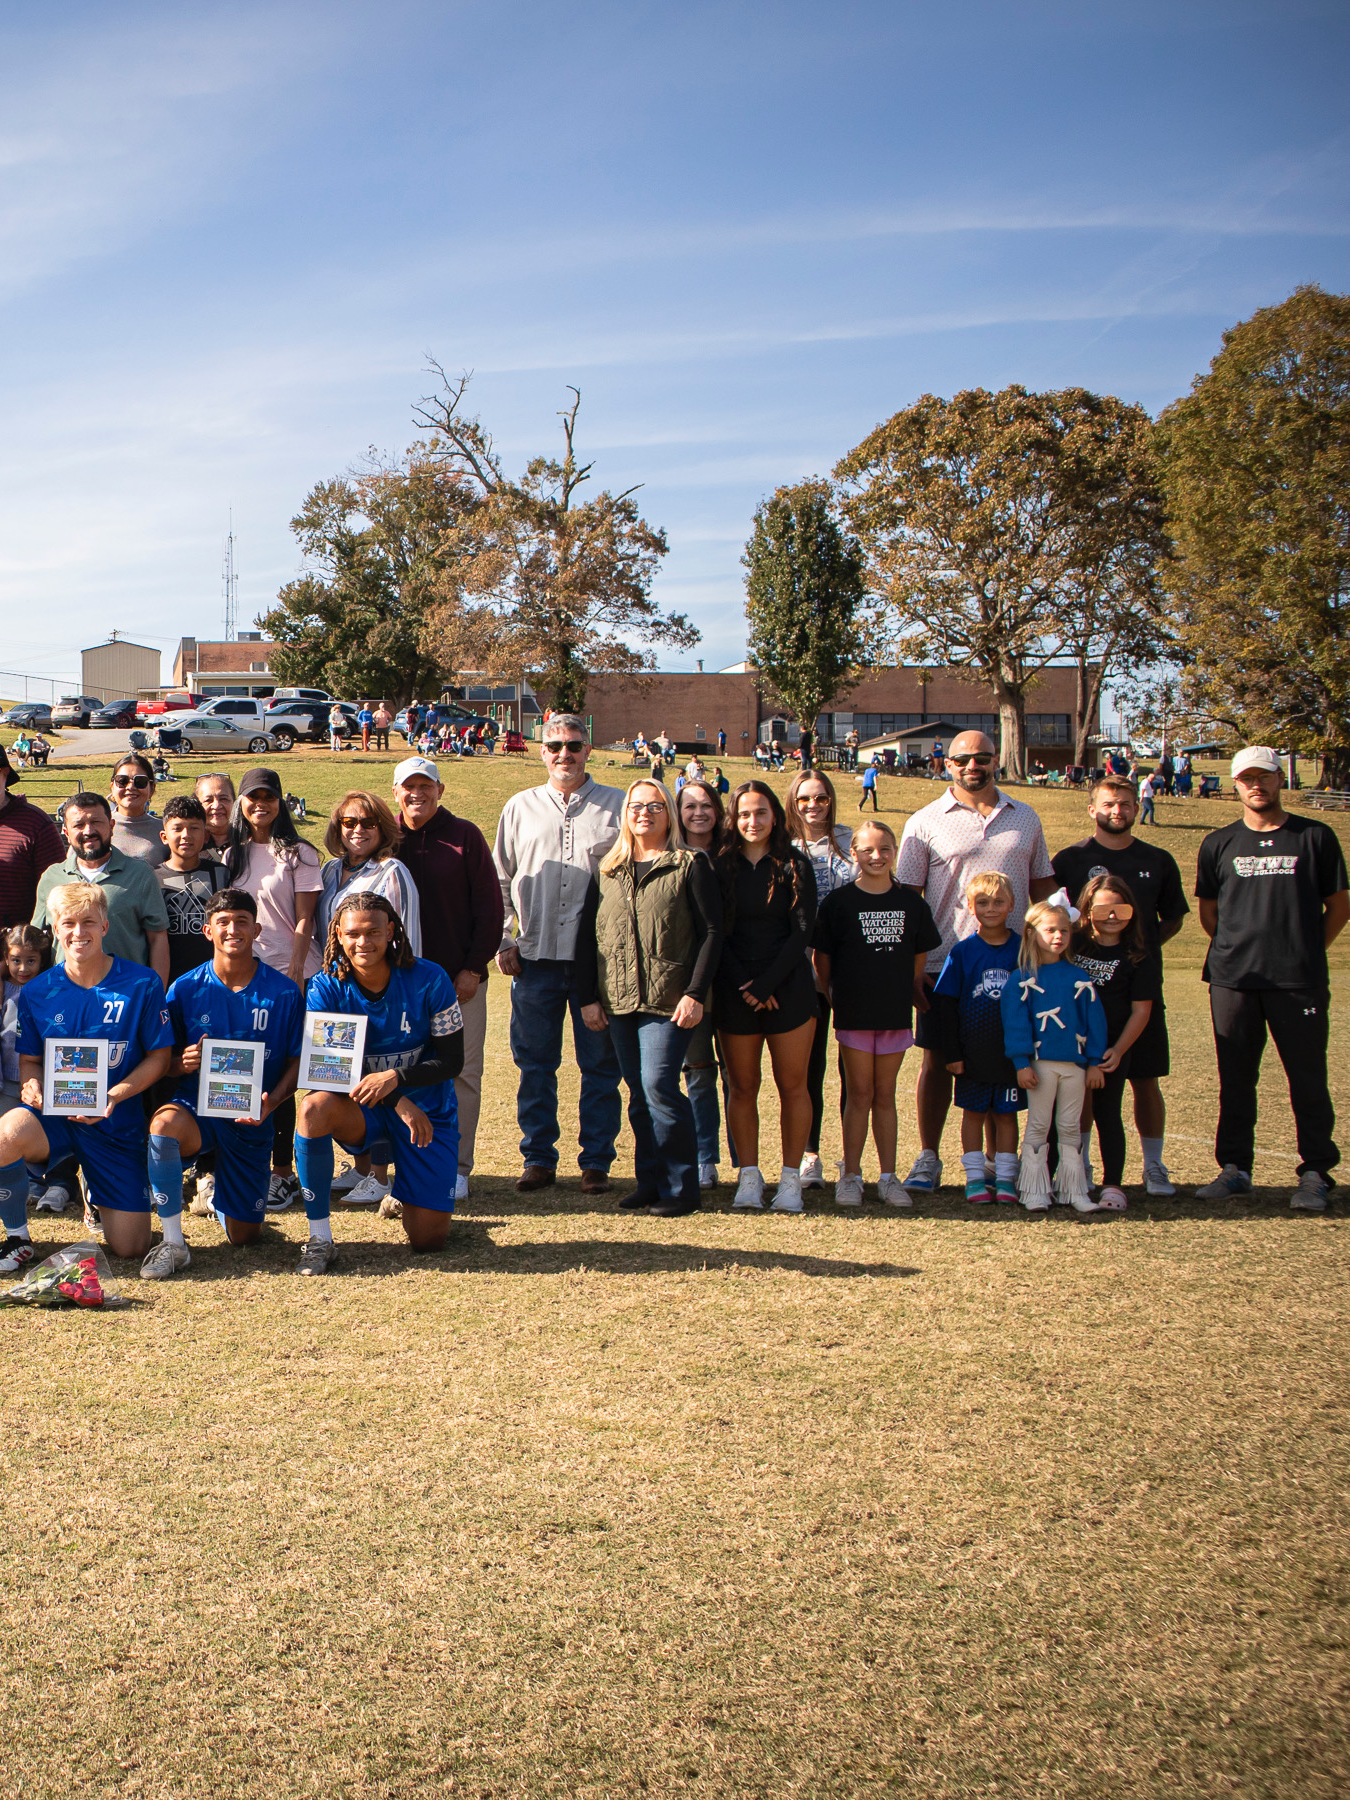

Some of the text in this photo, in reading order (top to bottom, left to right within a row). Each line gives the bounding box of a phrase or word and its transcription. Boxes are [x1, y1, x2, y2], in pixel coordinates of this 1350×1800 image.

[1254, 856, 1298, 869] TWU
[1254, 868, 1295, 876] BULLDOGS
[858, 911, 905, 920] EVERYONE
[168, 912, 206, 935] adid
[861, 919, 905, 928] WATCHES
[862, 927, 904, 936] WOMEN'S
[866, 934, 902, 943] SPORTS.
[103, 1001, 124, 1023] 27
[450, 1010, 461, 1025] C
[251, 1008, 269, 1031] 10
[400, 1011, 412, 1034] 4
[363, 1044, 425, 1072] WU
[1005, 1088, 1018, 1102] 18
